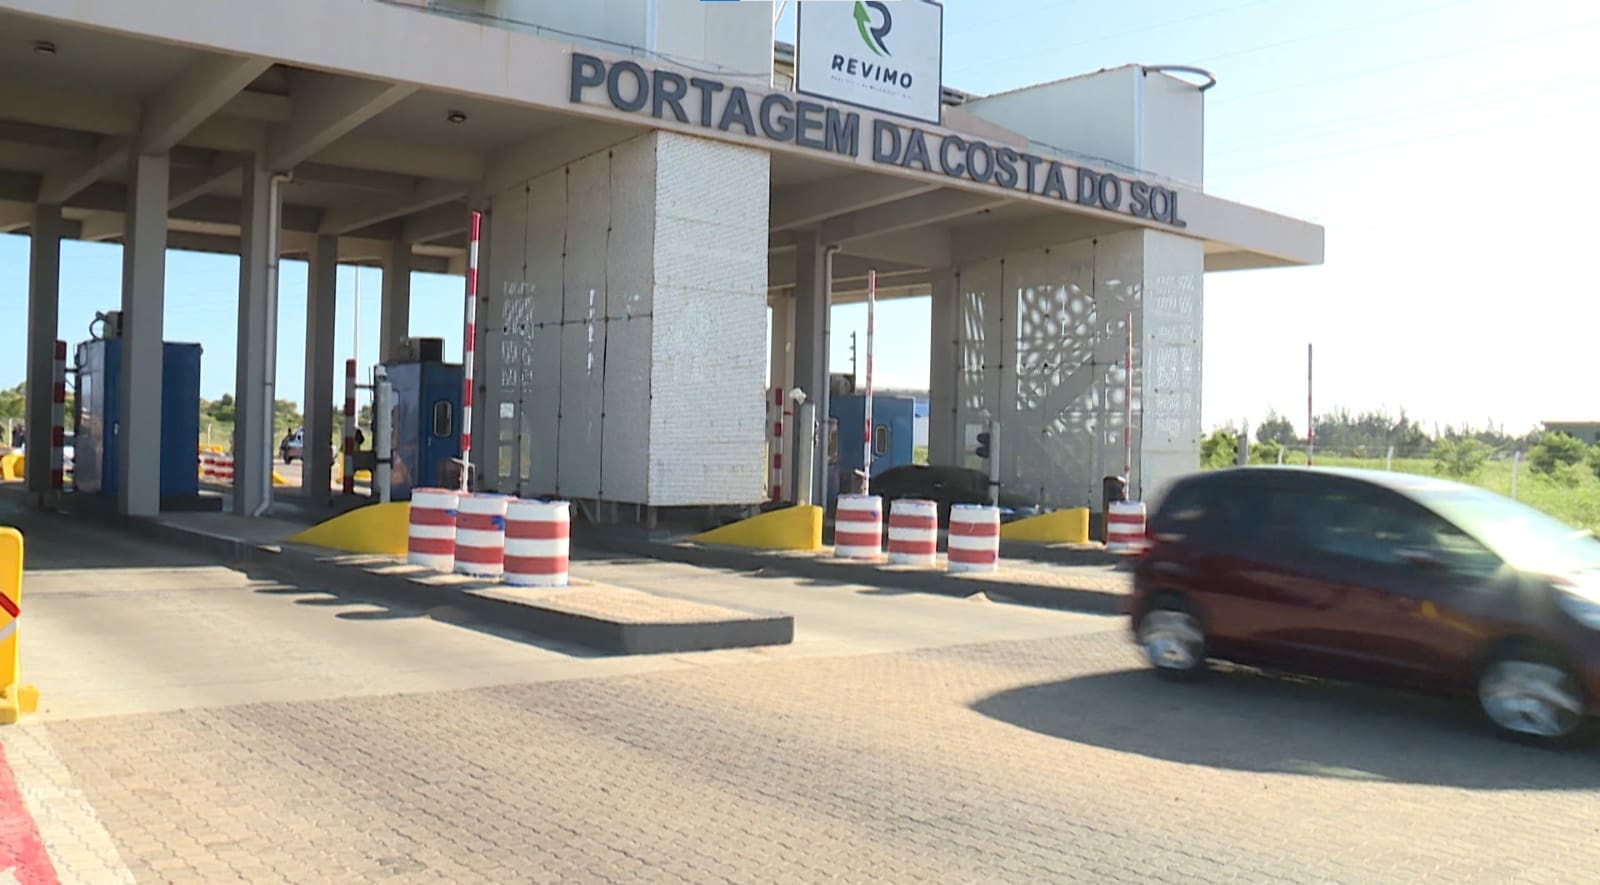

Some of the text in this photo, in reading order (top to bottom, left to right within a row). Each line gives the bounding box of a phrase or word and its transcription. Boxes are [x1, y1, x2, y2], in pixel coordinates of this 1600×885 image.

[831, 54, 912, 89] REVIMO
[570, 52, 860, 158] PORTAGEM
[873, 119, 932, 172] DA
[940, 135, 1068, 201] COSTA
[1076, 166, 1122, 211] DO
[1130, 180, 1187, 228] SOL
